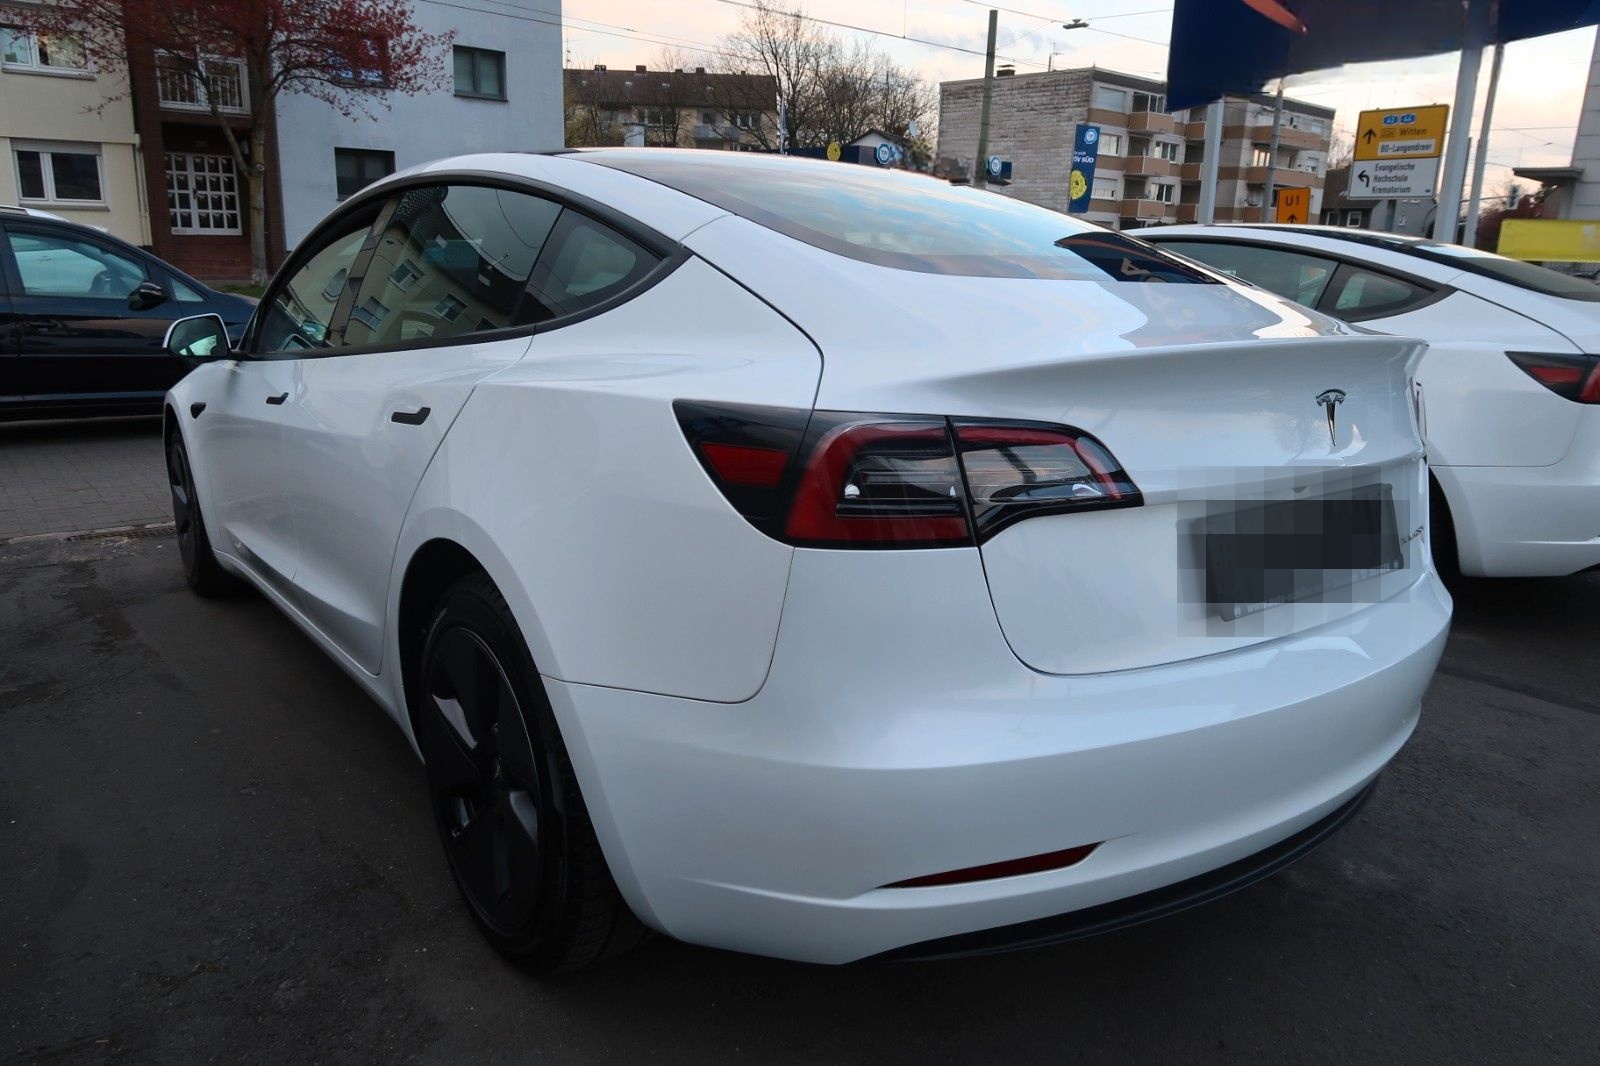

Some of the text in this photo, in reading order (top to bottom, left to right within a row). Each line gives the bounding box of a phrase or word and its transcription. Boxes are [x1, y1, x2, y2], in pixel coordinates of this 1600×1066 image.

[1400, 127, 1428, 136] Witten
[1375, 162, 1415, 173] Evangelische
[1373, 175, 1409, 183] Hochschule
[1371, 185, 1412, 194] Krematorium
